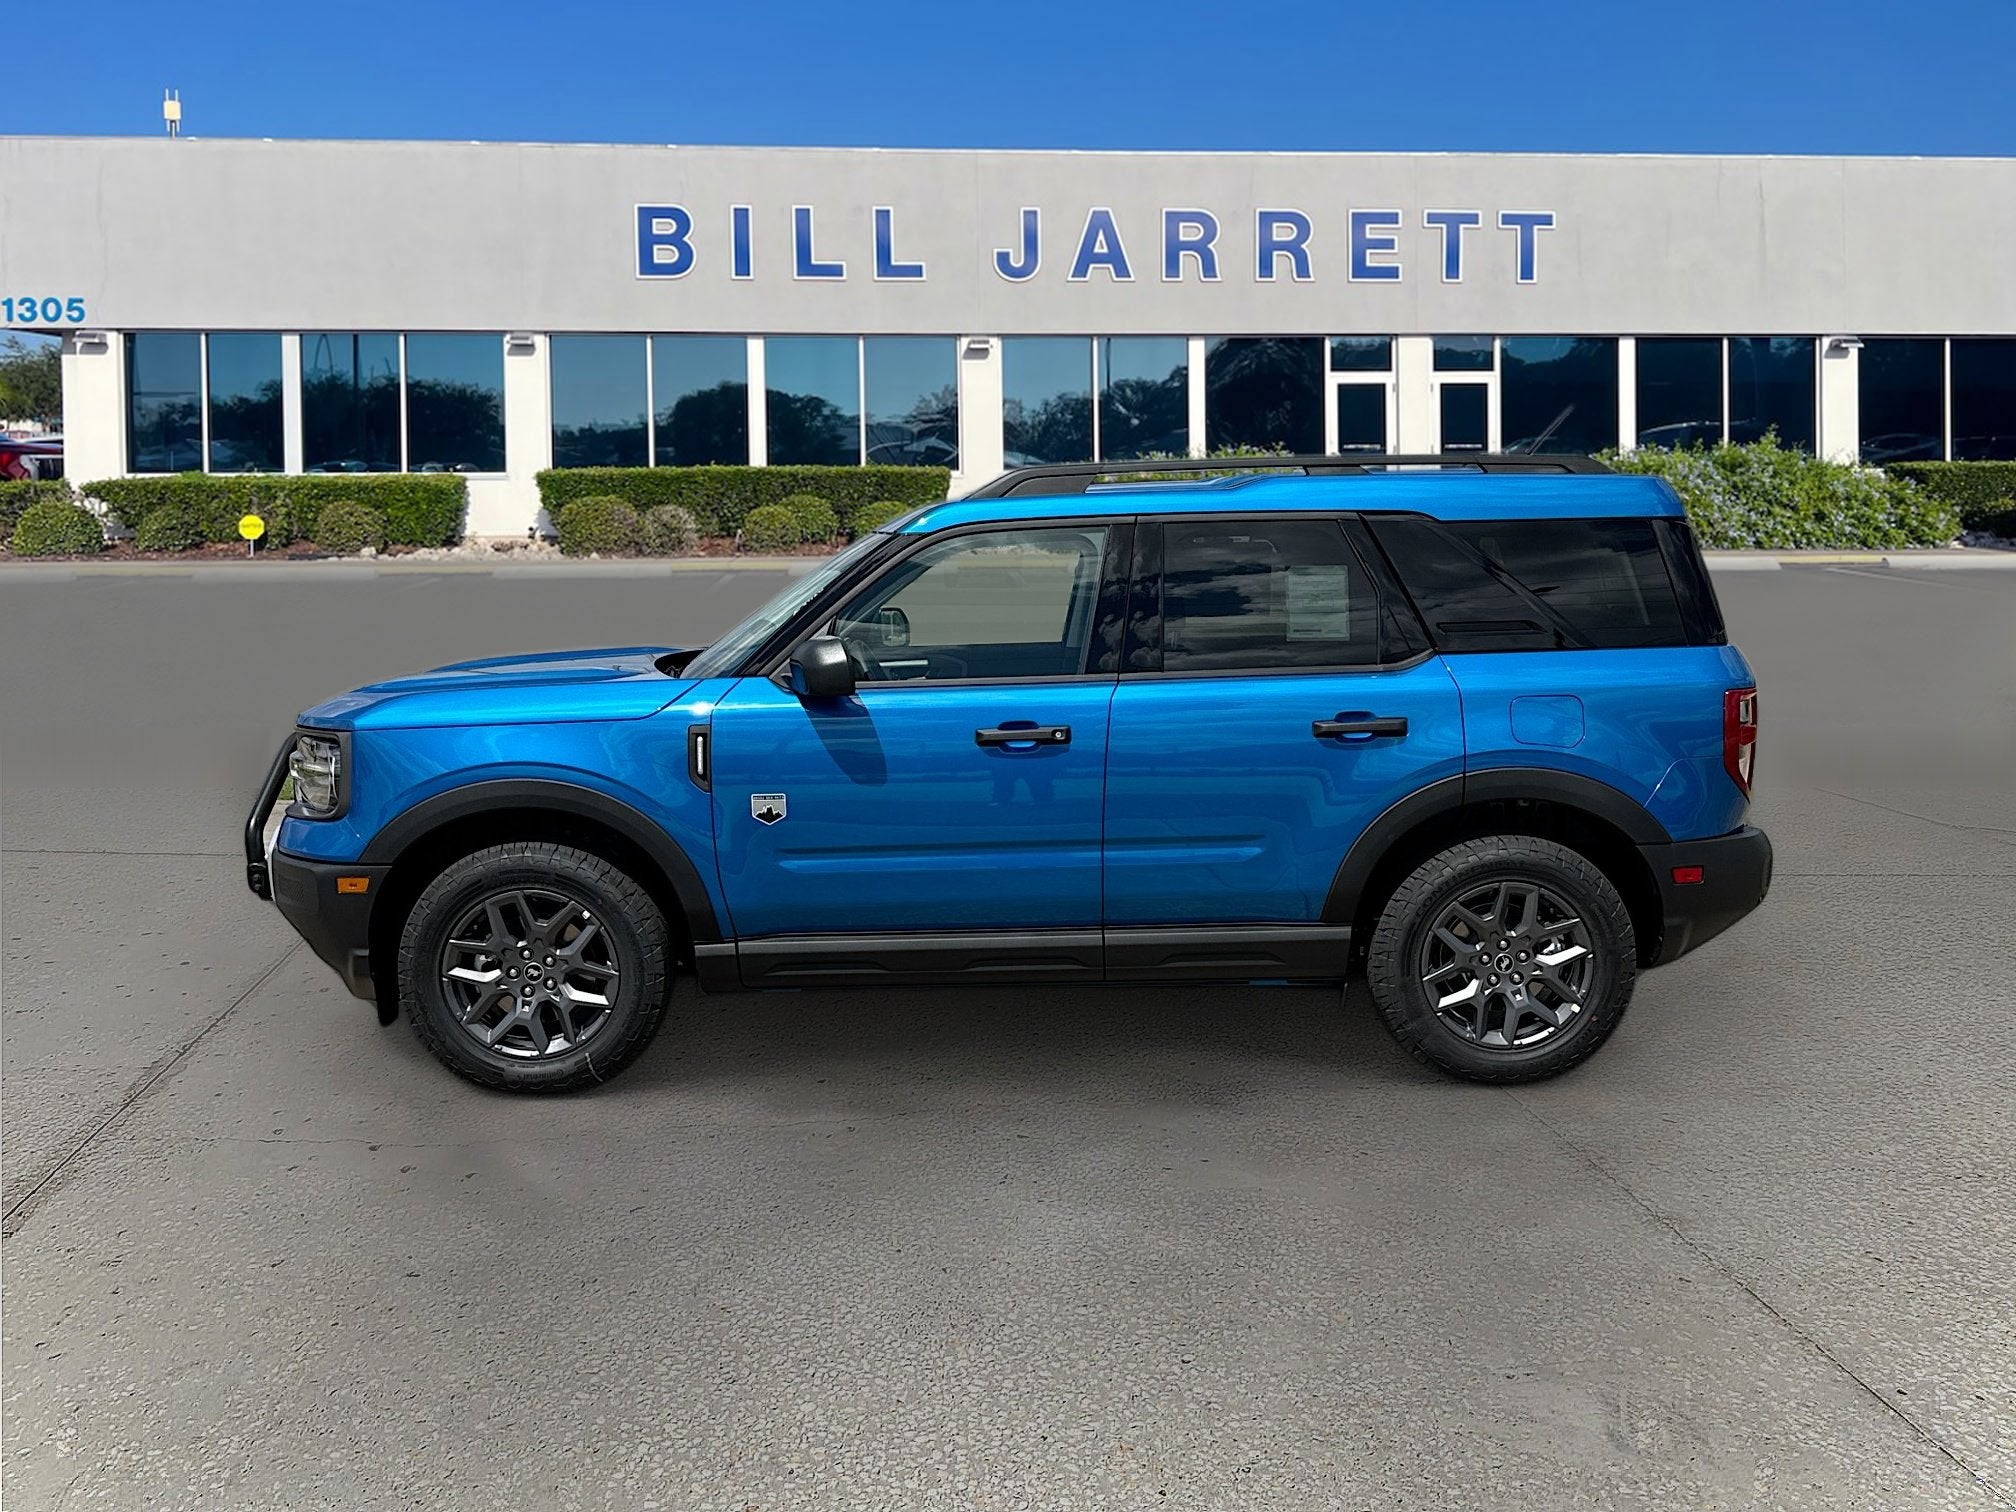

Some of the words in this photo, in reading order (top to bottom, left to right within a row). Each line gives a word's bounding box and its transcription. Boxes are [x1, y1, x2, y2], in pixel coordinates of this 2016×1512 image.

[634, 204, 927, 281] BILL
[992, 207, 1556, 284] JARRETT
[1, 297, 86, 323] 1305
